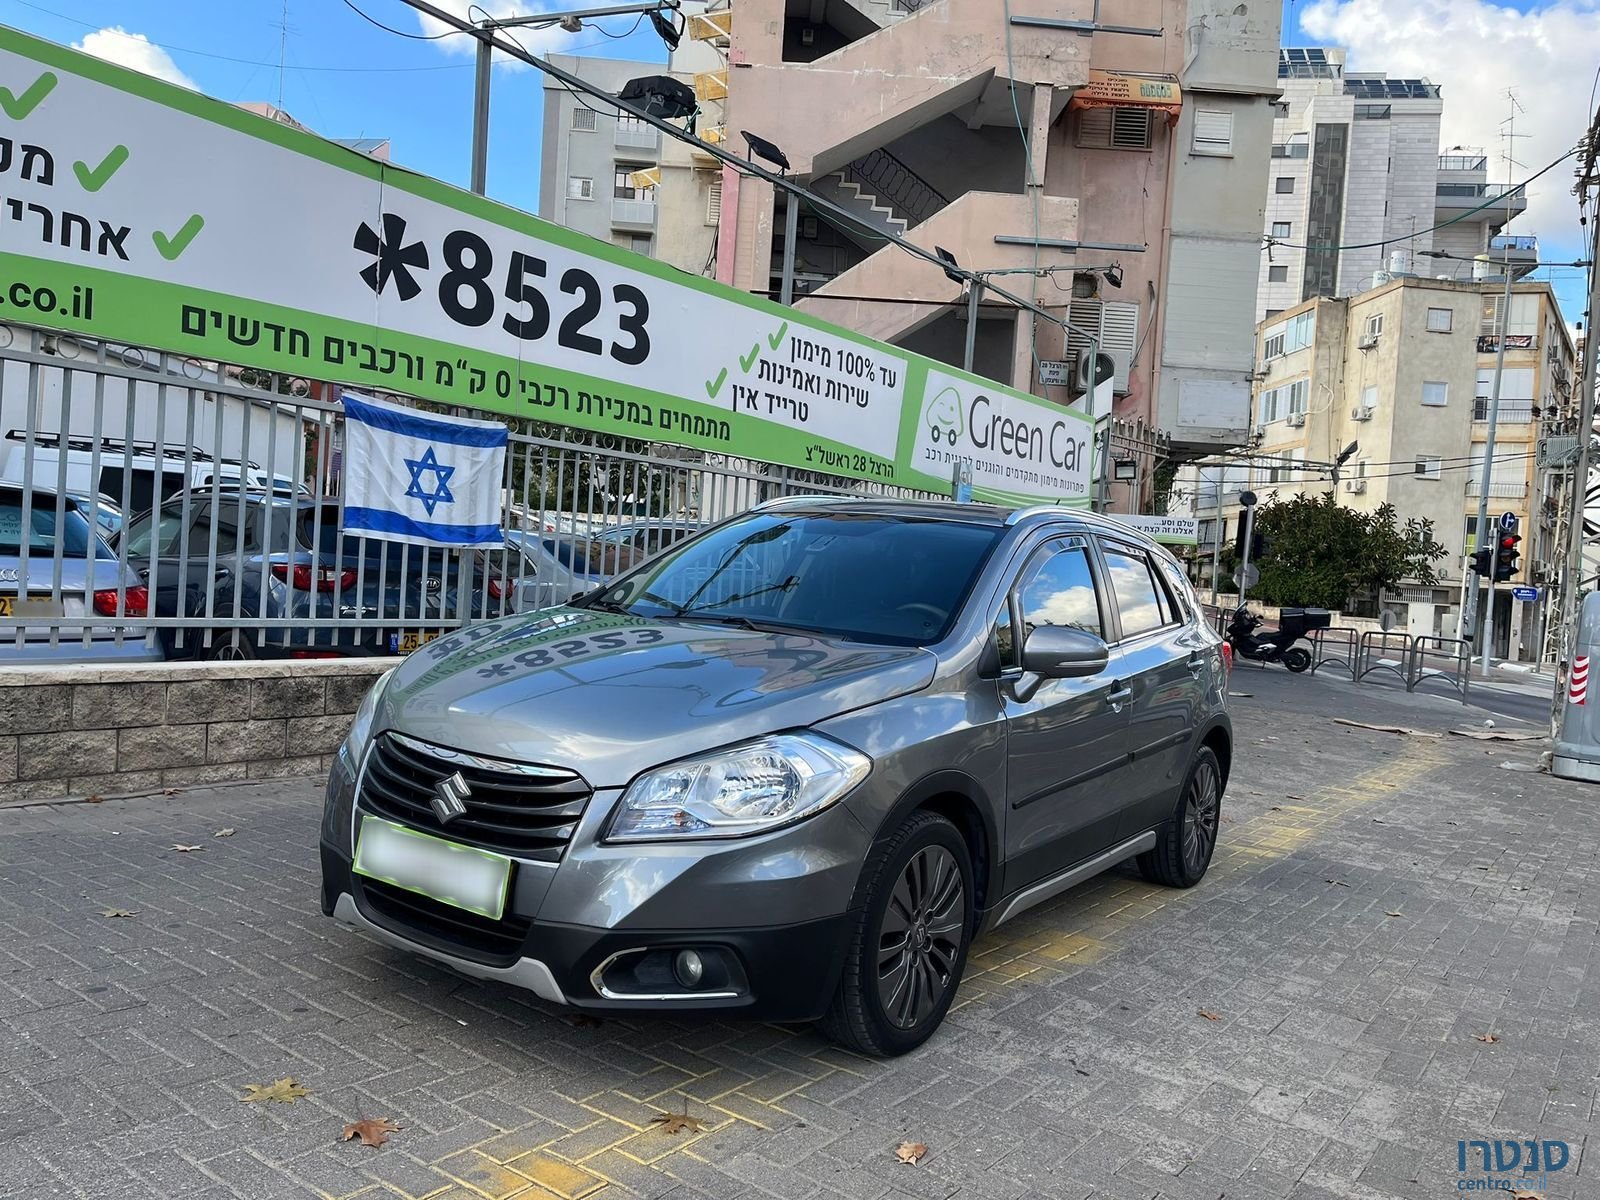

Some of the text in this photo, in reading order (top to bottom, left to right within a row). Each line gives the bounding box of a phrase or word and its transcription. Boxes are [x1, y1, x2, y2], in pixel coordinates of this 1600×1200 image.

[181, 303, 310, 358] חדשים
[323, 335, 424, 381] ורכבים
[791, 336, 897, 388] עד 100% מימון
[495, 370, 511, 398] 0
[518, 379, 570, 410] רכבי
[758, 359, 869, 408] שירות ואמינות
[576, 390, 653, 427] במכירת
[732, 384, 809, 422] טרייד אין
[659, 407, 731, 441] מתמחים
[969, 395, 1086, 473] Green Car
[852, 454, 867, 472] 28
[869, 458, 894, 479] הרצל
[925, 447, 942, 462] רכב
[975, 458, 1004, 477] והוגנים
[1005, 465, 1039, 484] מתקדמים
[1040, 473, 1058, 488] מימון
[1172, 527, 1194, 535] אצלנו
[1177, 519, 1194, 527] שלם
